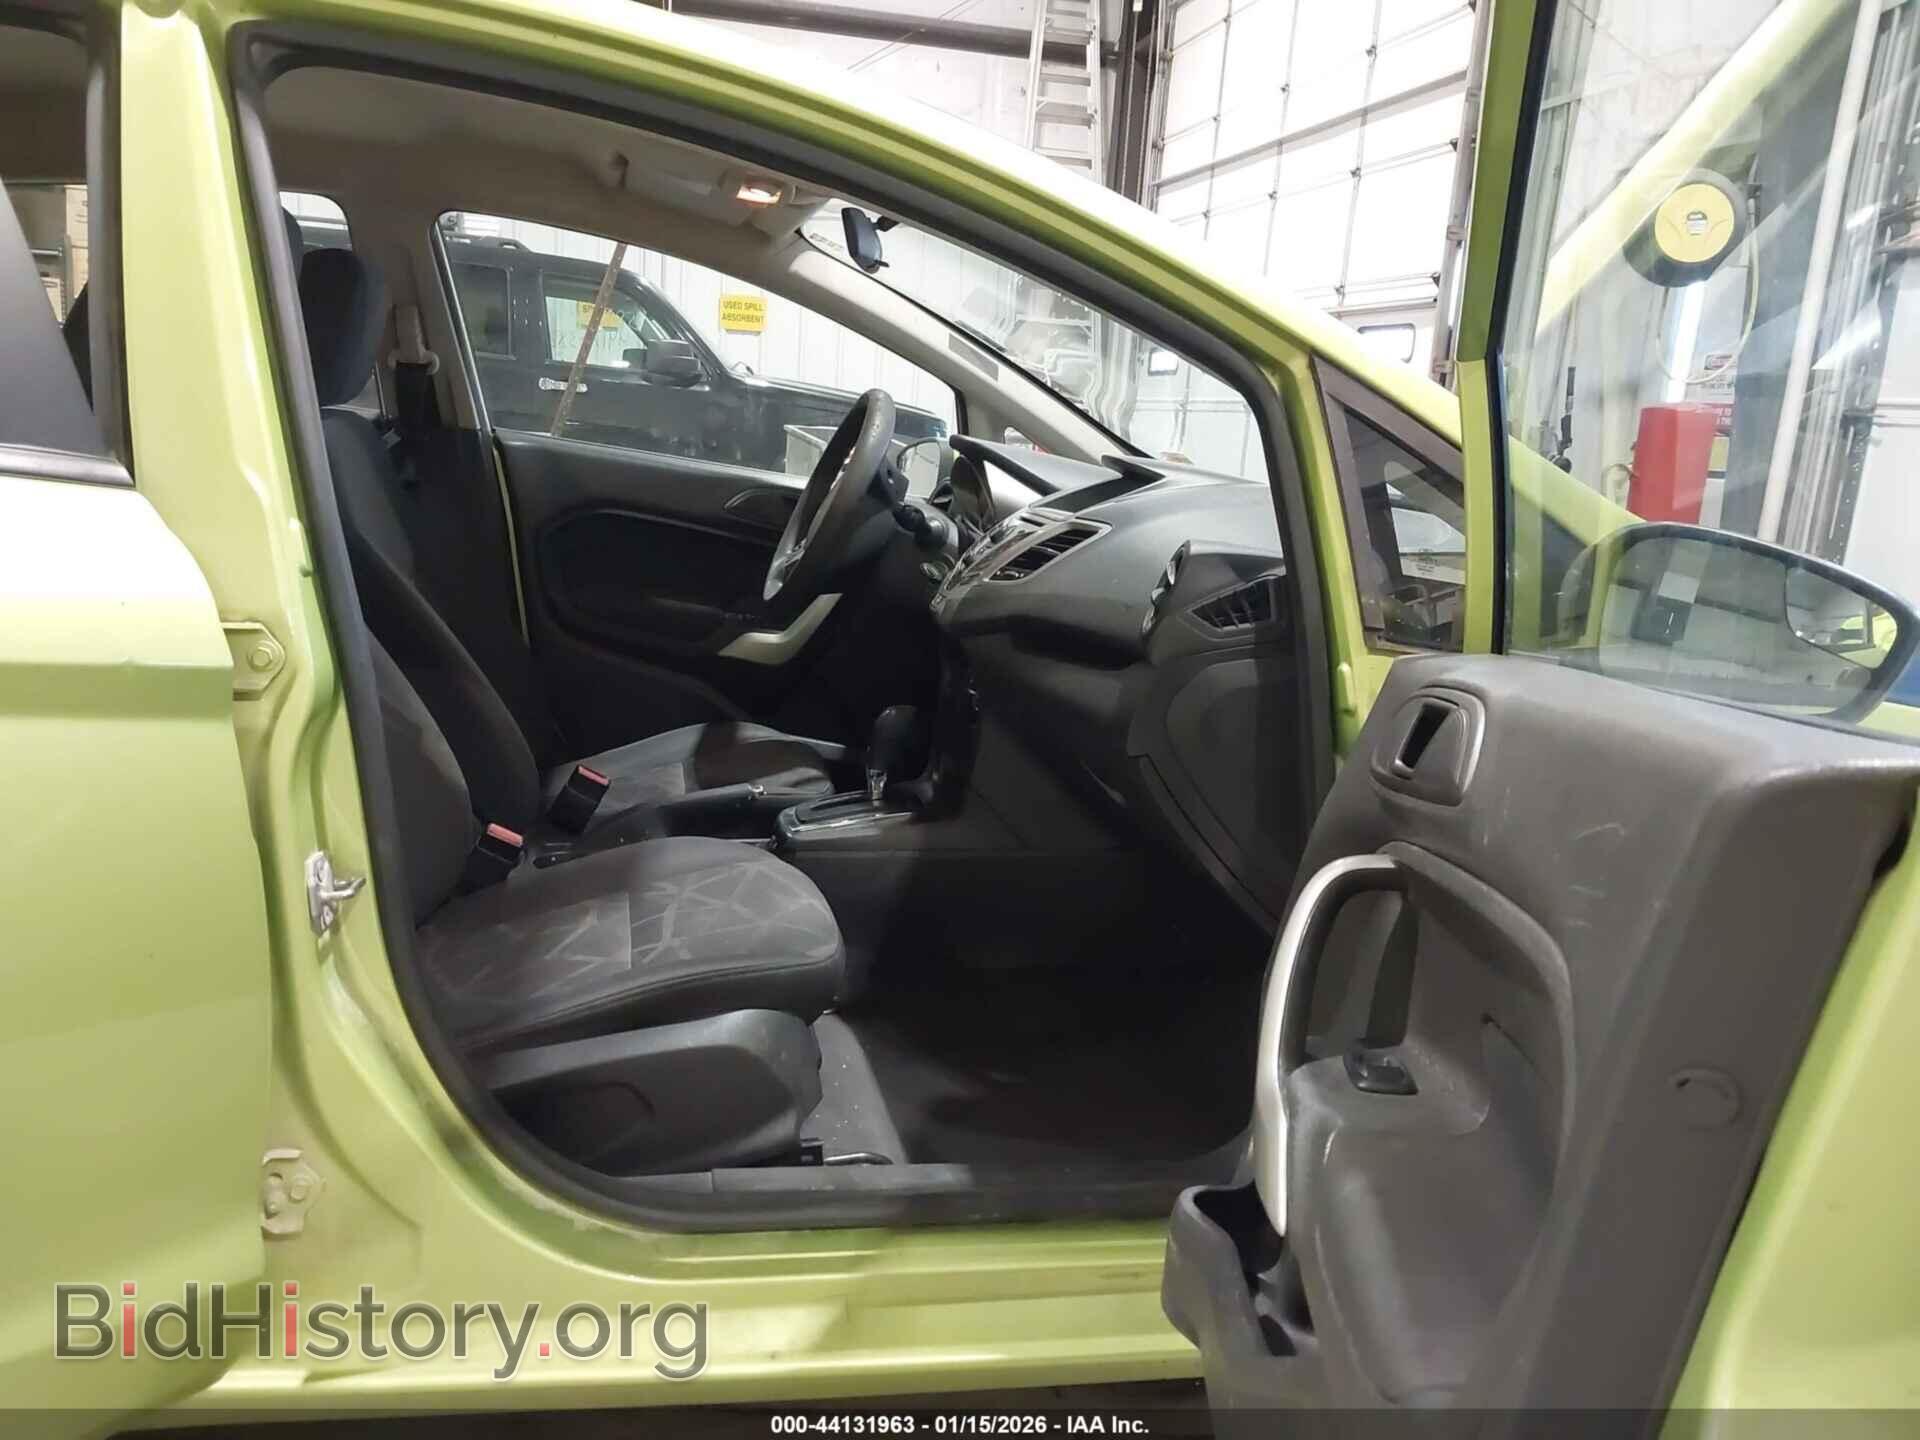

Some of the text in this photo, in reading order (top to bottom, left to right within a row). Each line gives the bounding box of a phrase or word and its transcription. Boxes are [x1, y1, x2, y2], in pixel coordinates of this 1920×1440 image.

[723, 300, 765, 312] USED SPILL
[721, 313, 765, 323] ABSORBENT
